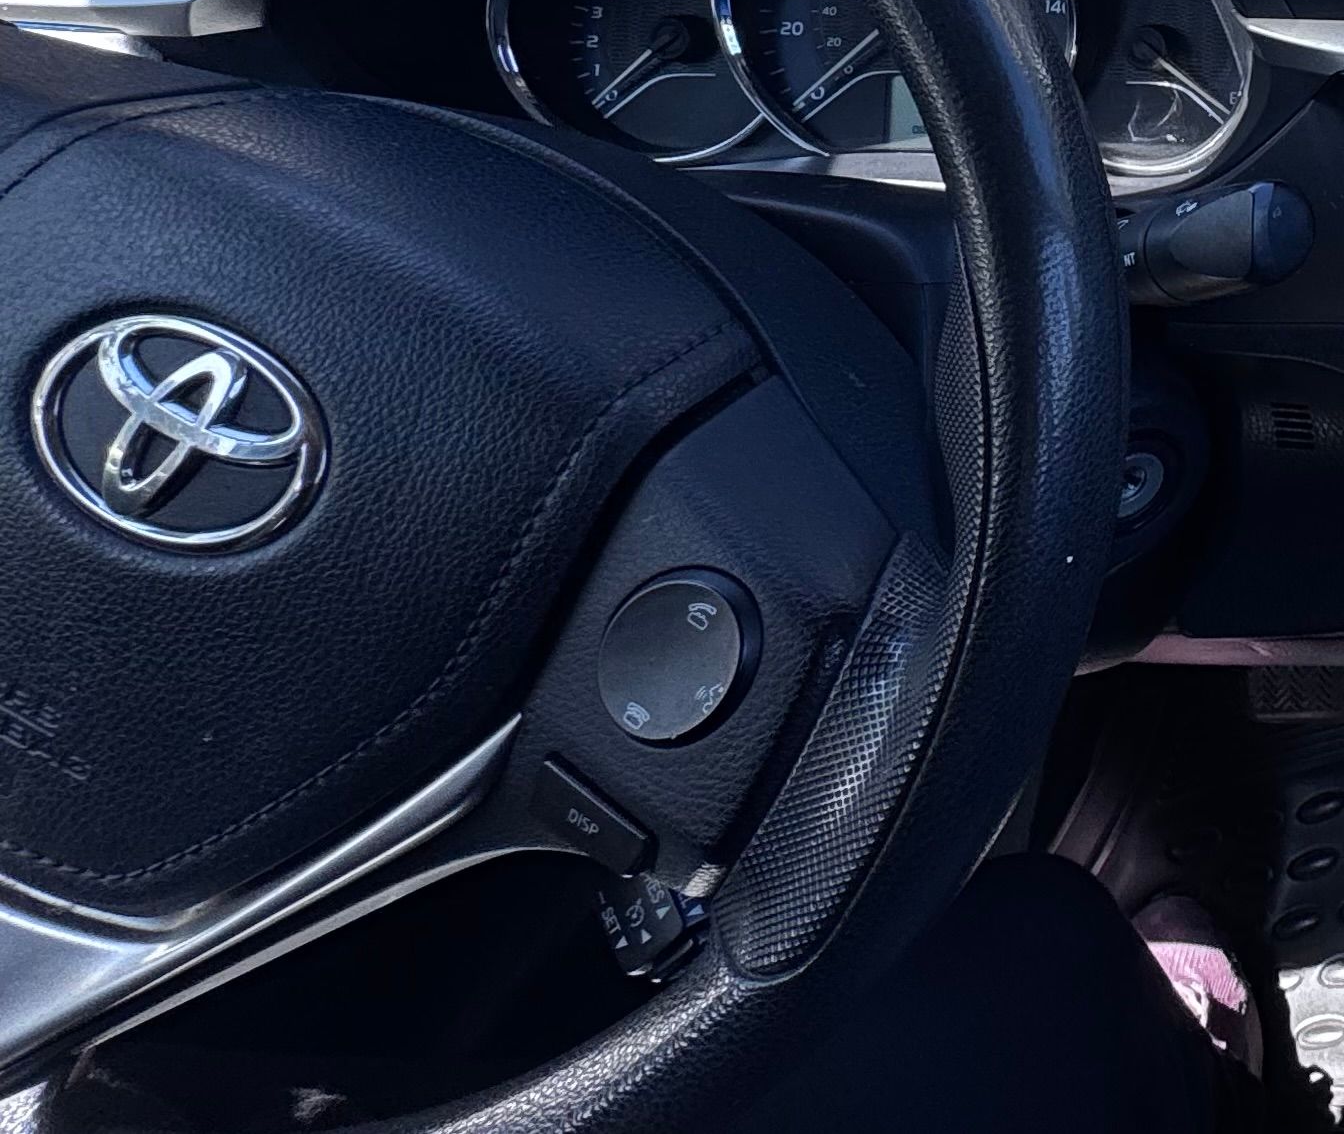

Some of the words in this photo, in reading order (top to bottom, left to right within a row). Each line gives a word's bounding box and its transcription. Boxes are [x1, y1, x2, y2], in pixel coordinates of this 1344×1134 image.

[590, 5, 604, 19] 3
[821, 5, 838, 17] 40
[779, 21, 804, 37] 20
[585, 34, 600, 49] 2
[826, 36, 843, 48] 20
[567, 807, 600, 836] DISP
[601, 905, 622, 935] SET
